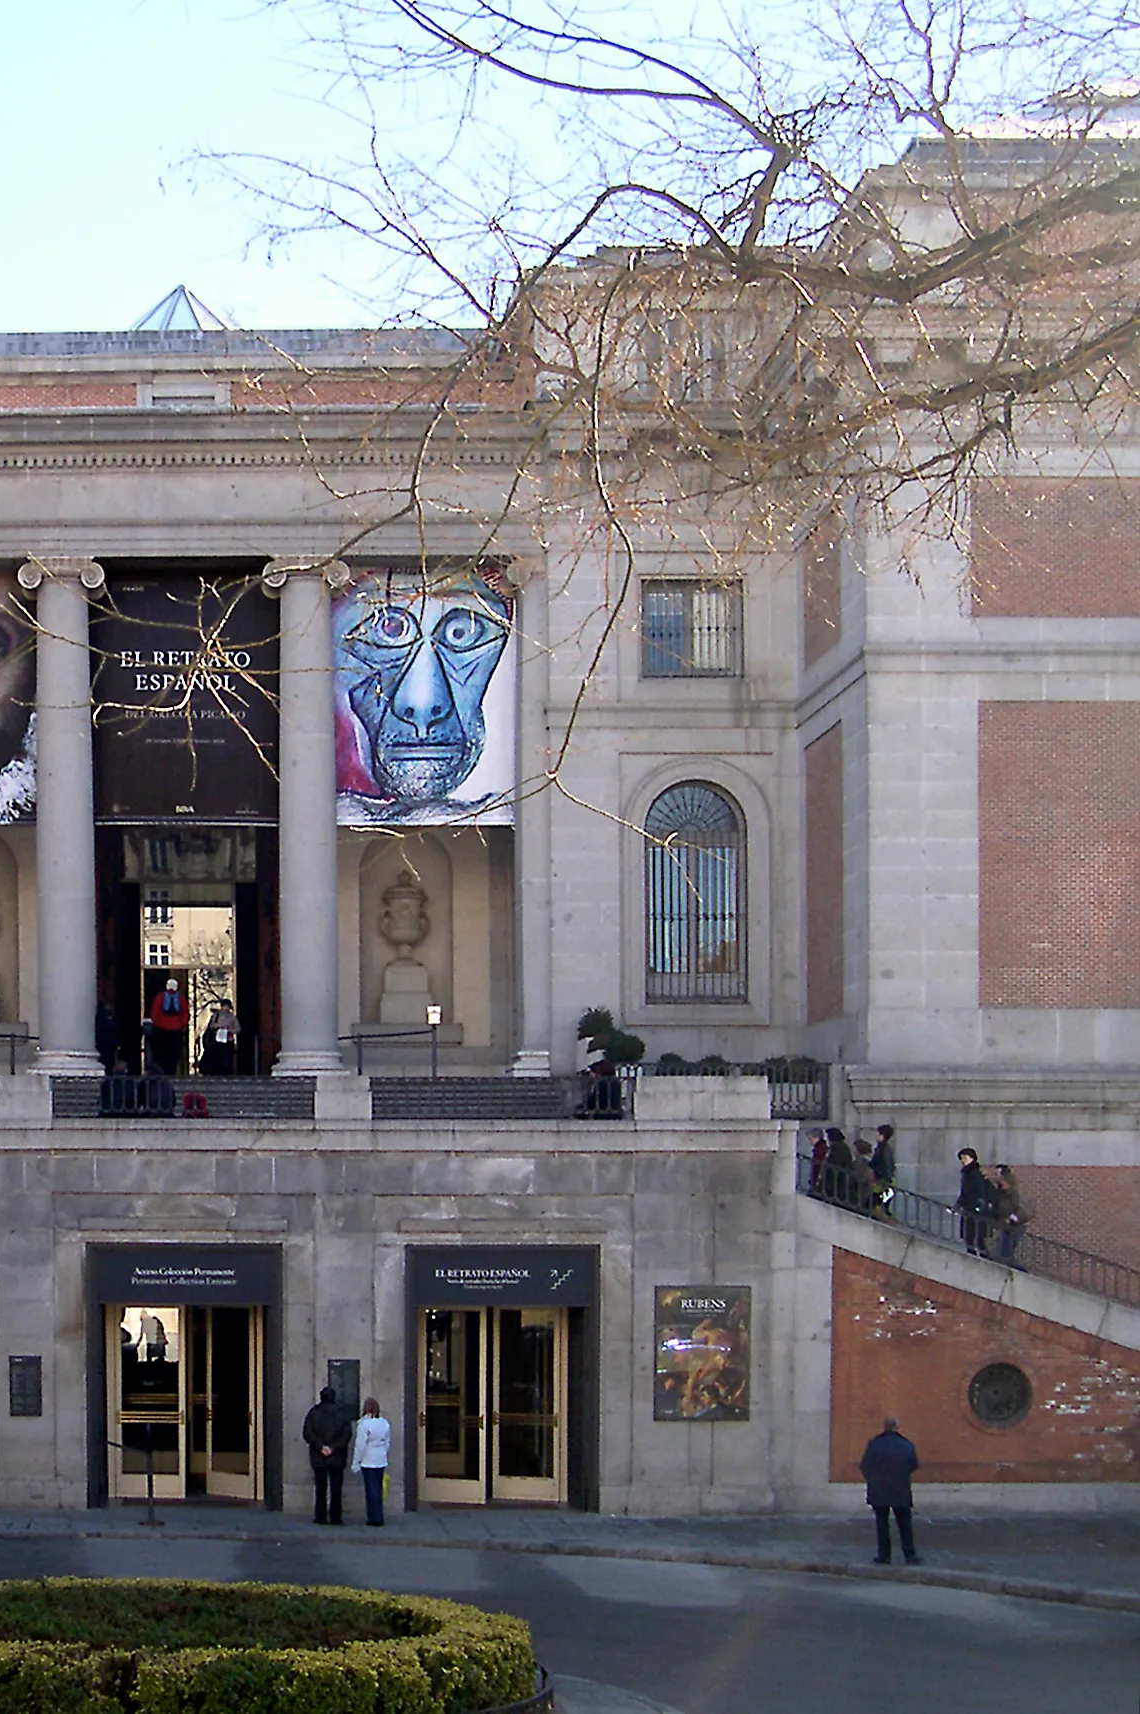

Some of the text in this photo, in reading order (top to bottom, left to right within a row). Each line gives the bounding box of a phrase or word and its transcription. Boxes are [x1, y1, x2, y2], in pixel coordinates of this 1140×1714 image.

[120, 651, 251, 668] EL RETRATO
[435, 1267, 531, 1278] EL RETRATO ESPAÑOL
[680, 1299, 727, 1309] RUBENS
